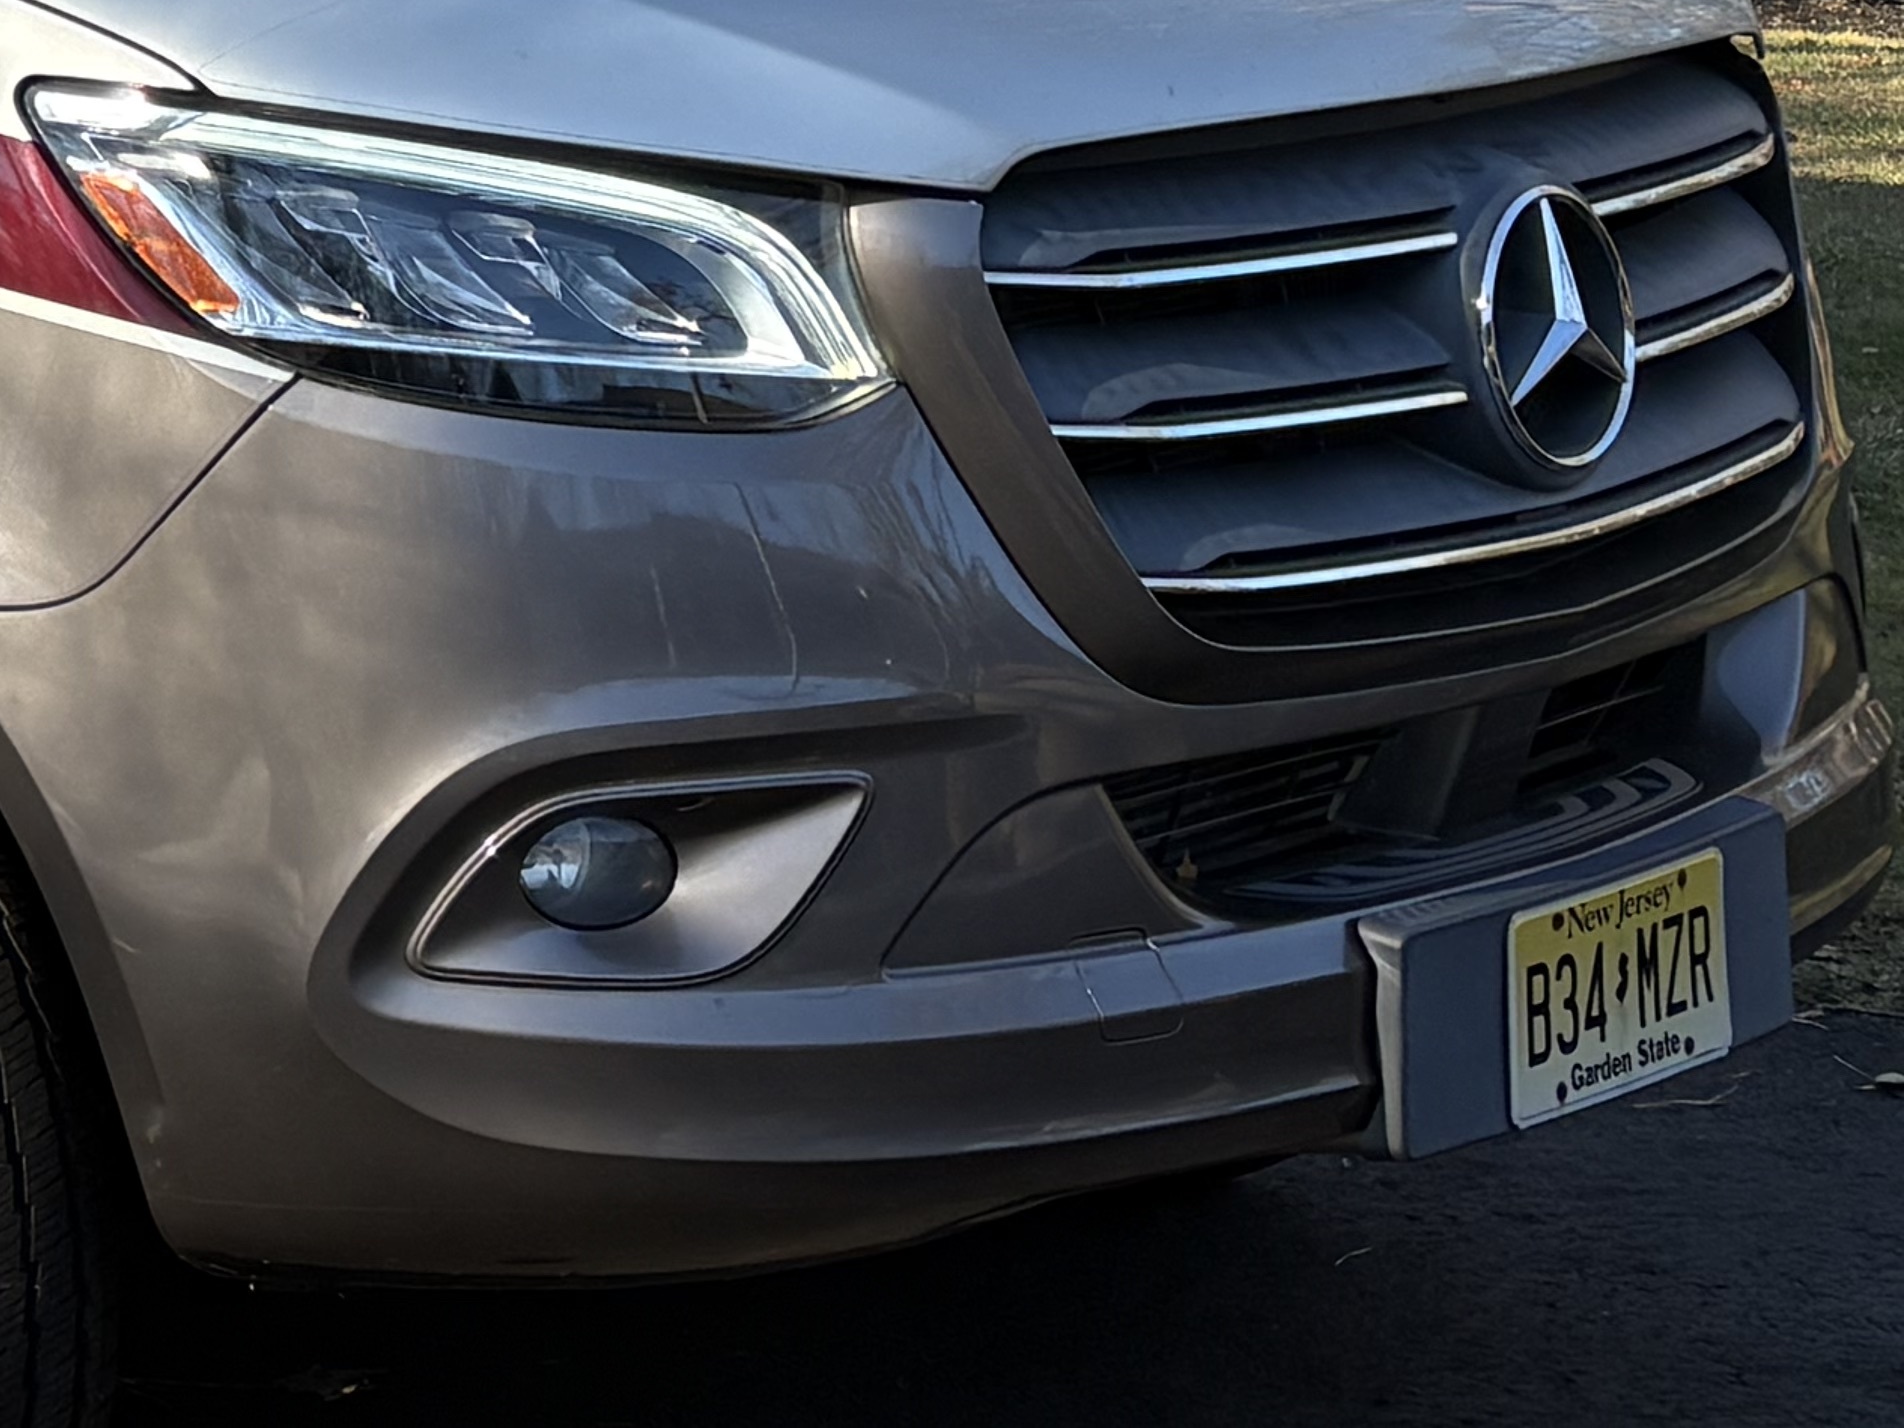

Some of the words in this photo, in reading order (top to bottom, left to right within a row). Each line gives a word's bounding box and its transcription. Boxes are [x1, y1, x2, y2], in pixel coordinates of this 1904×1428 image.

[1567, 904, 1613, 939] New
[1616, 880, 1675, 929] Jersey
[1570, 1049, 1632, 1092] Garden
[1638, 1031, 1681, 1067] State
